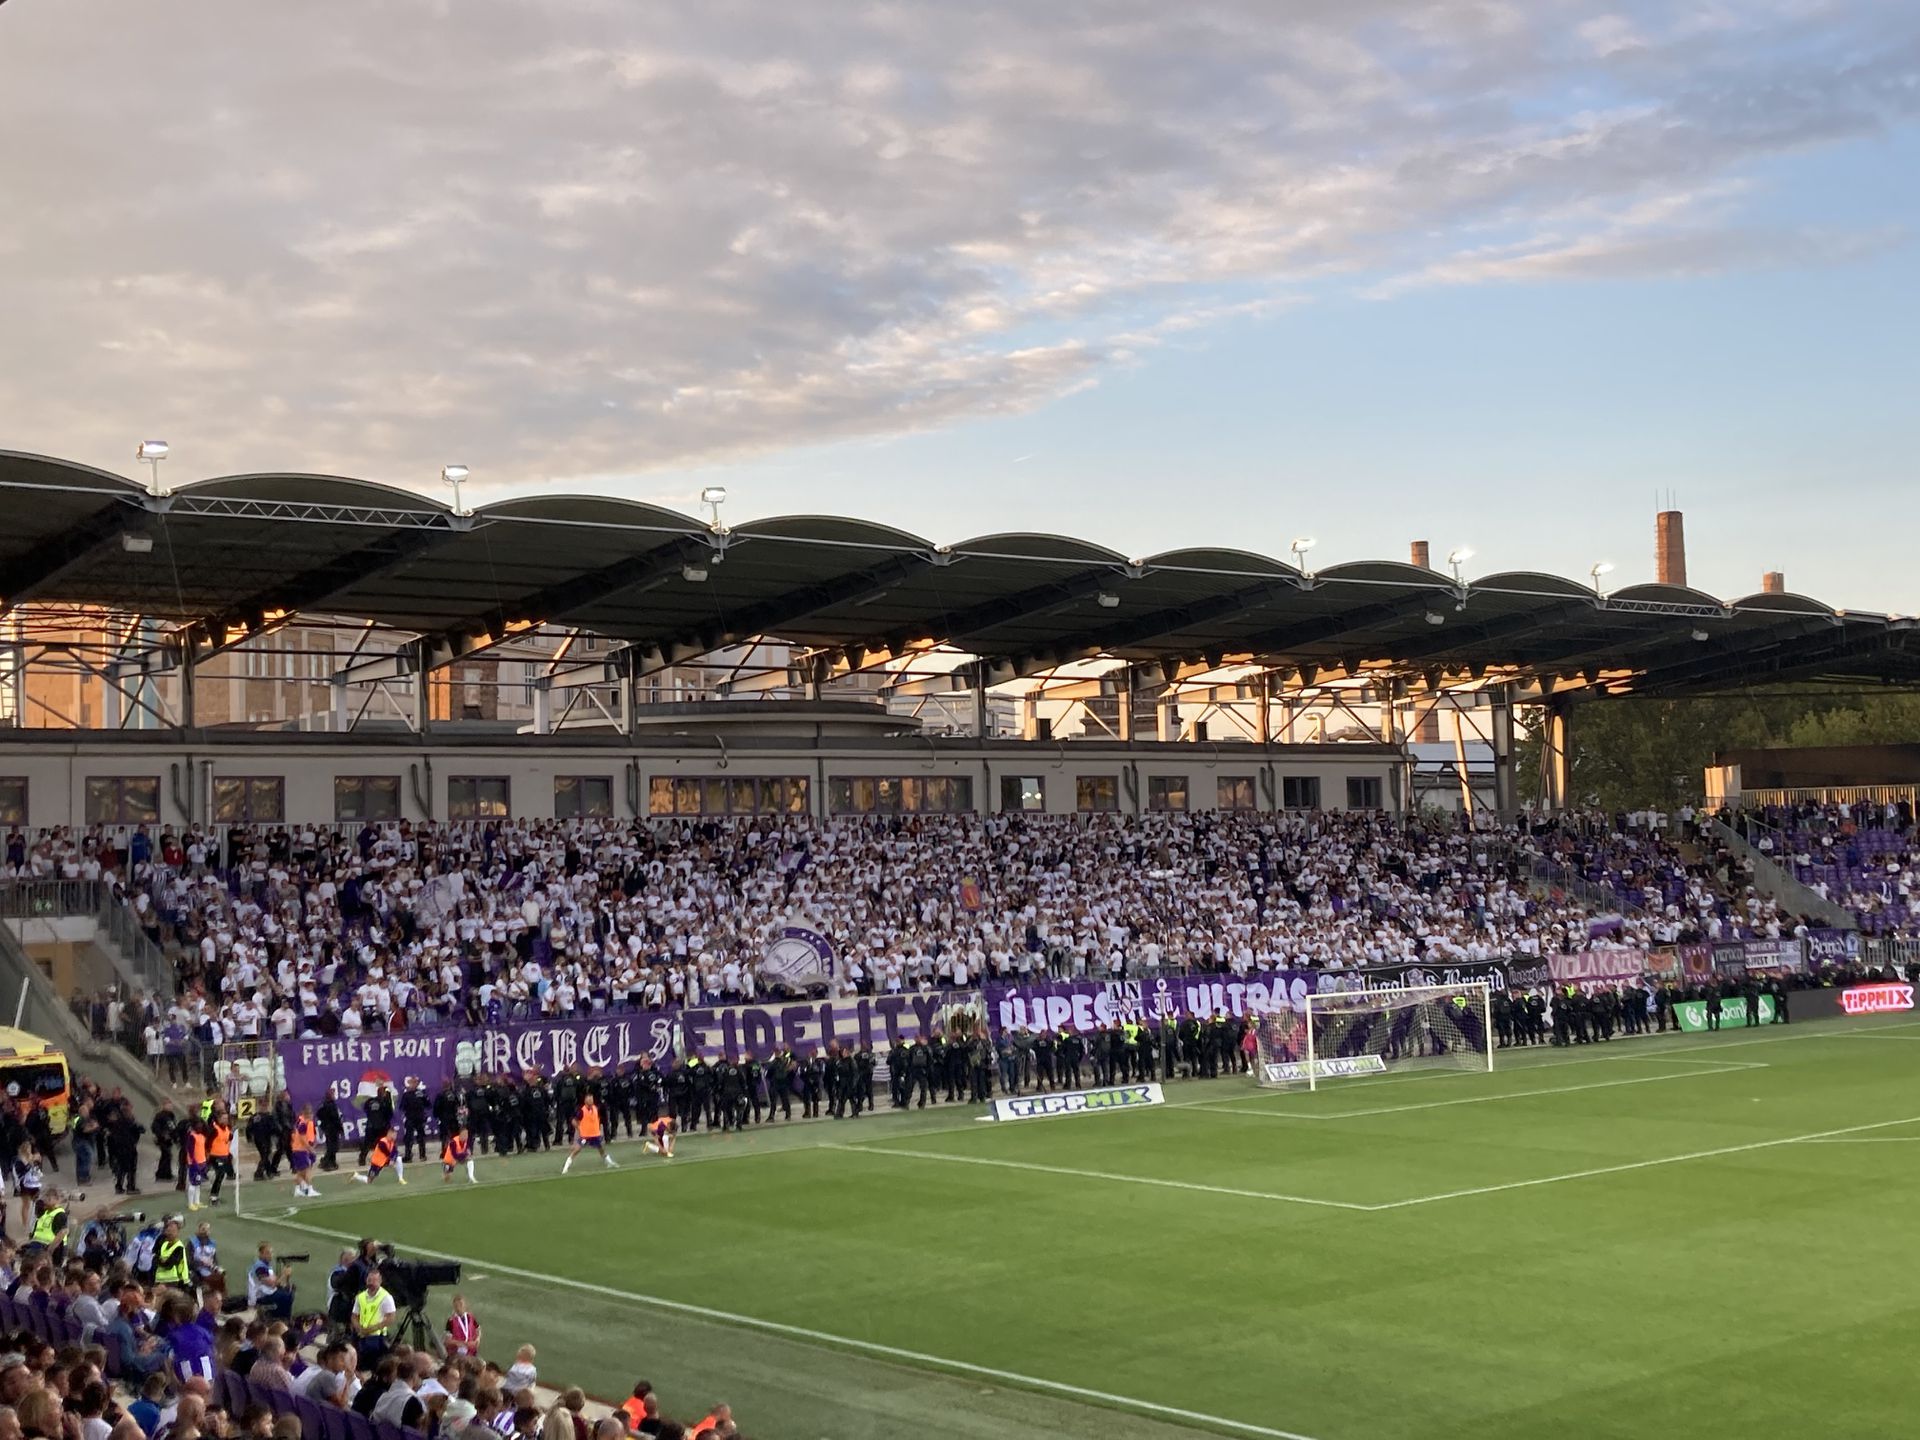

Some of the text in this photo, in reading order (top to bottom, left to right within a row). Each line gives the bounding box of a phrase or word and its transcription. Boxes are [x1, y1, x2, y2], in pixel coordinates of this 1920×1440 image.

[1187, 977, 1309, 1020] ULTRAS
[380, 1037, 446, 1061] FRONT
[483, 1018, 674, 1077] REBELS
[682, 995, 940, 1061] FIDELITY
[241, 1101, 254, 1116] 2
